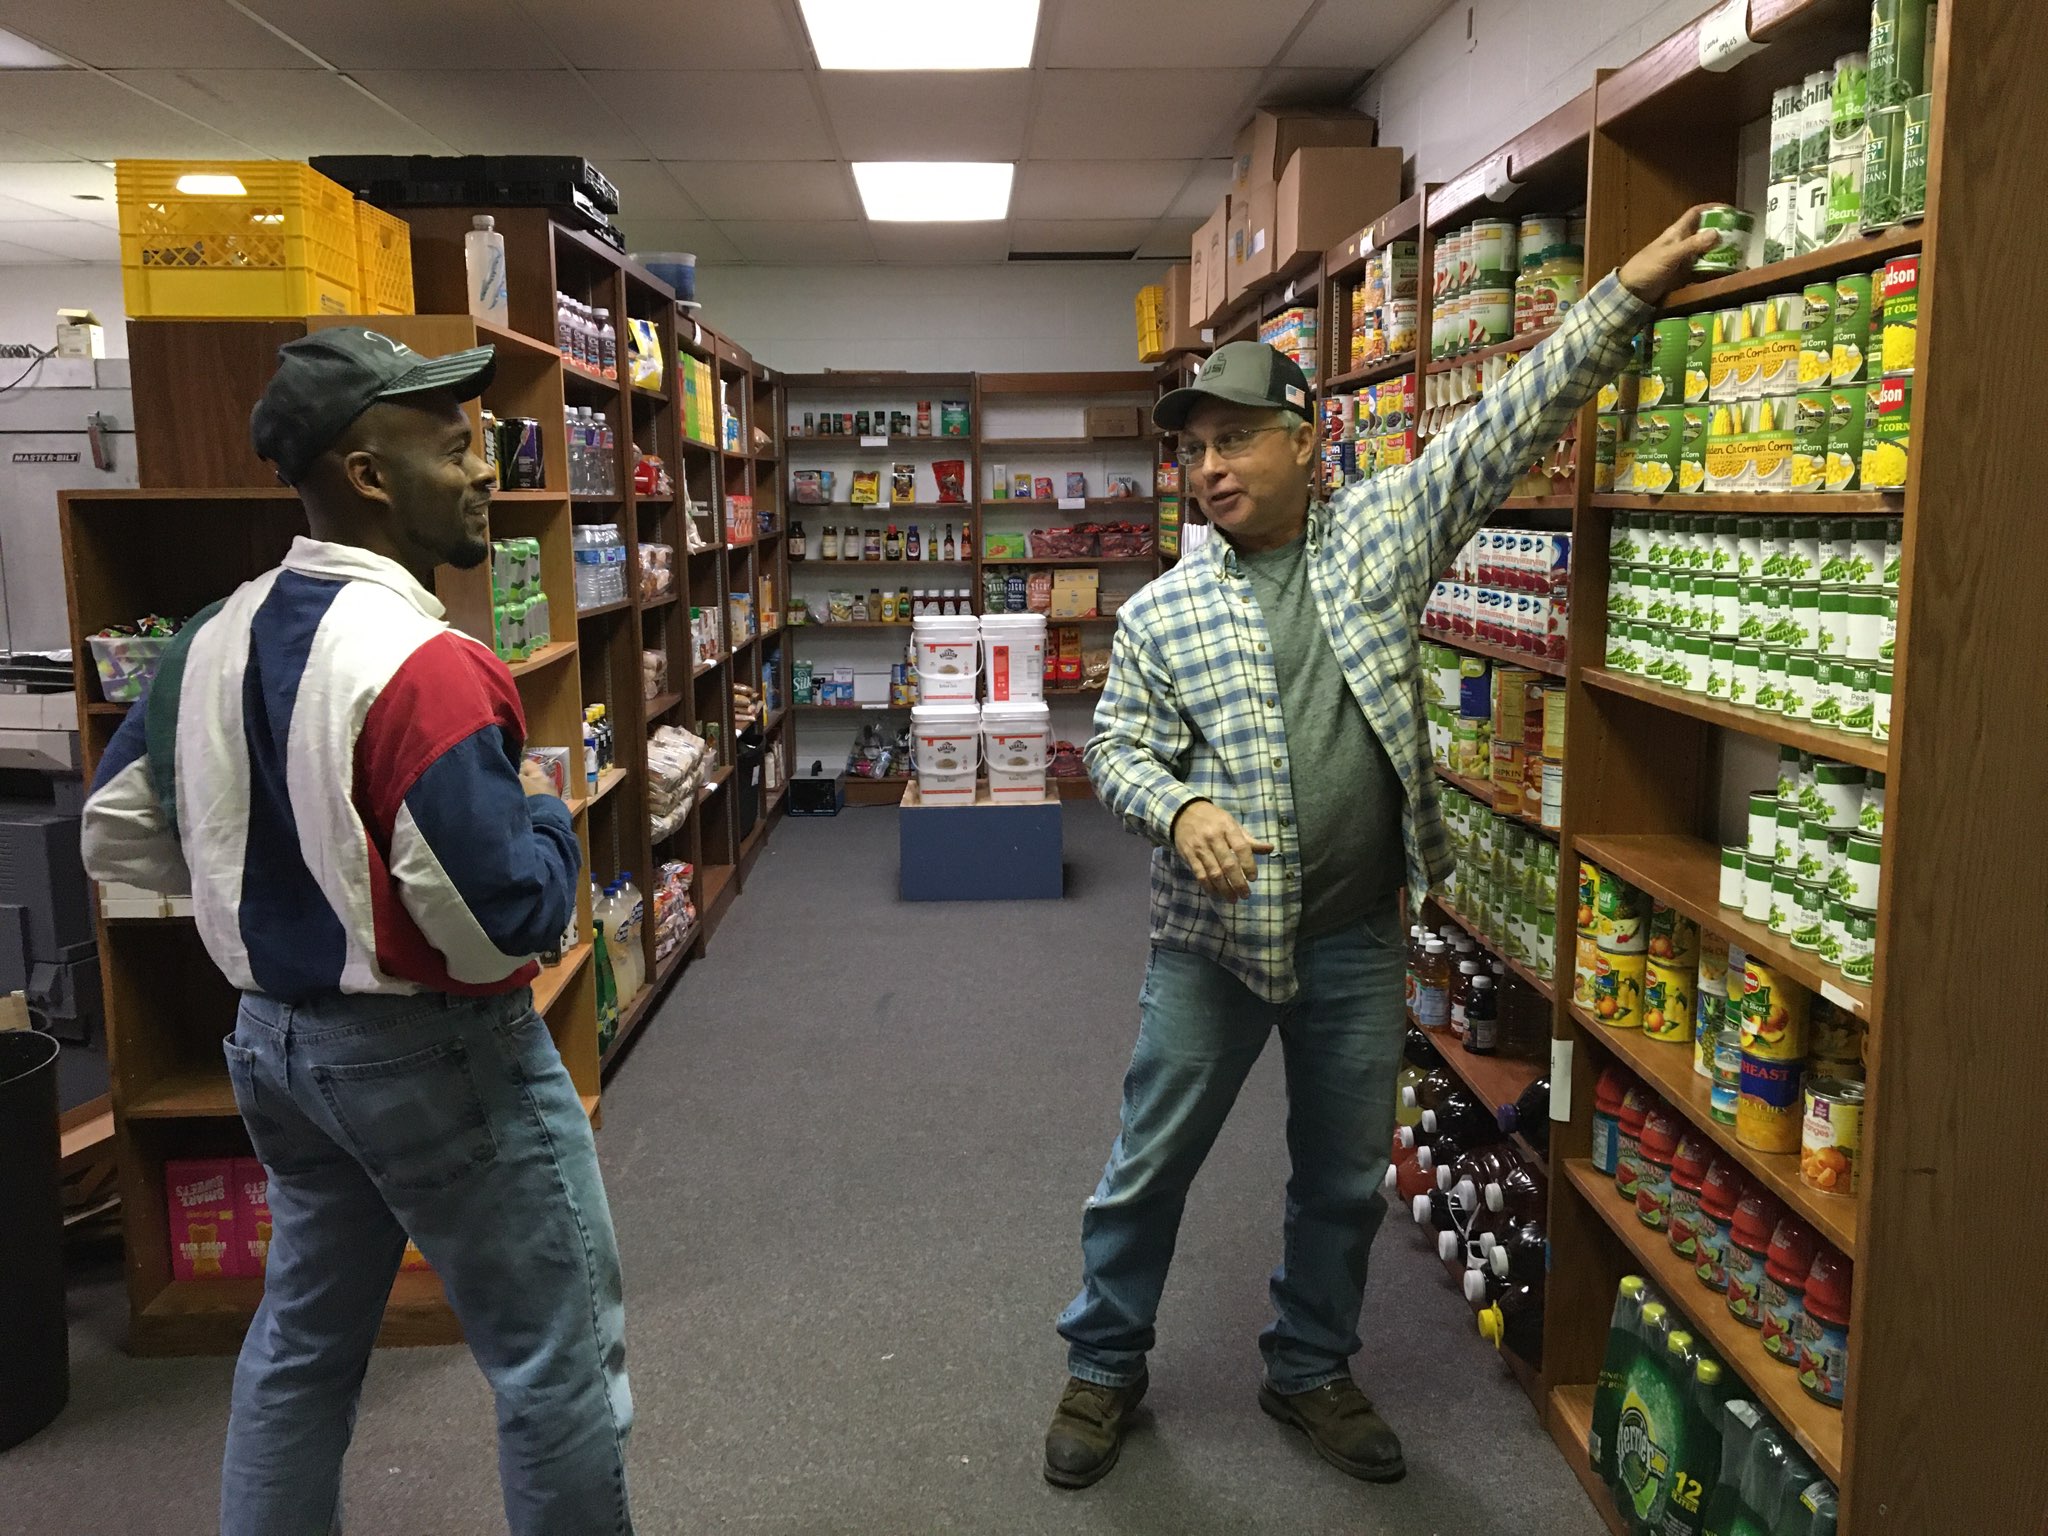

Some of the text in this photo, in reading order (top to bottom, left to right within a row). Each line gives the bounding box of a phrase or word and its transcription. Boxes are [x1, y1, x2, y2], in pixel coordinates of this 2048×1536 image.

[1839, 333, 1856, 341] Corn
[1771, 341, 1798, 353] Corn
[1808, 339, 1827, 348] Corn
[1718, 352, 1740, 363] Corn
[1689, 360, 1703, 368] Corn
[1737, 443, 1758, 454] Corn
[1767, 440, 1793, 452] Corn
[1833, 441, 1849, 449] Corn
[13, 453, 78, 462] MASTER-BILT
[1686, 450, 1700, 459] Corn
[793, 676, 812, 692] Silk
[1851, 693, 1870, 701] Peas
[1801, 911, 1819, 921] Peas
[1850, 940, 1868, 951] Peas
[1749, 1001, 1767, 1013] Slices
[1675, 1471, 1703, 1506] 12
